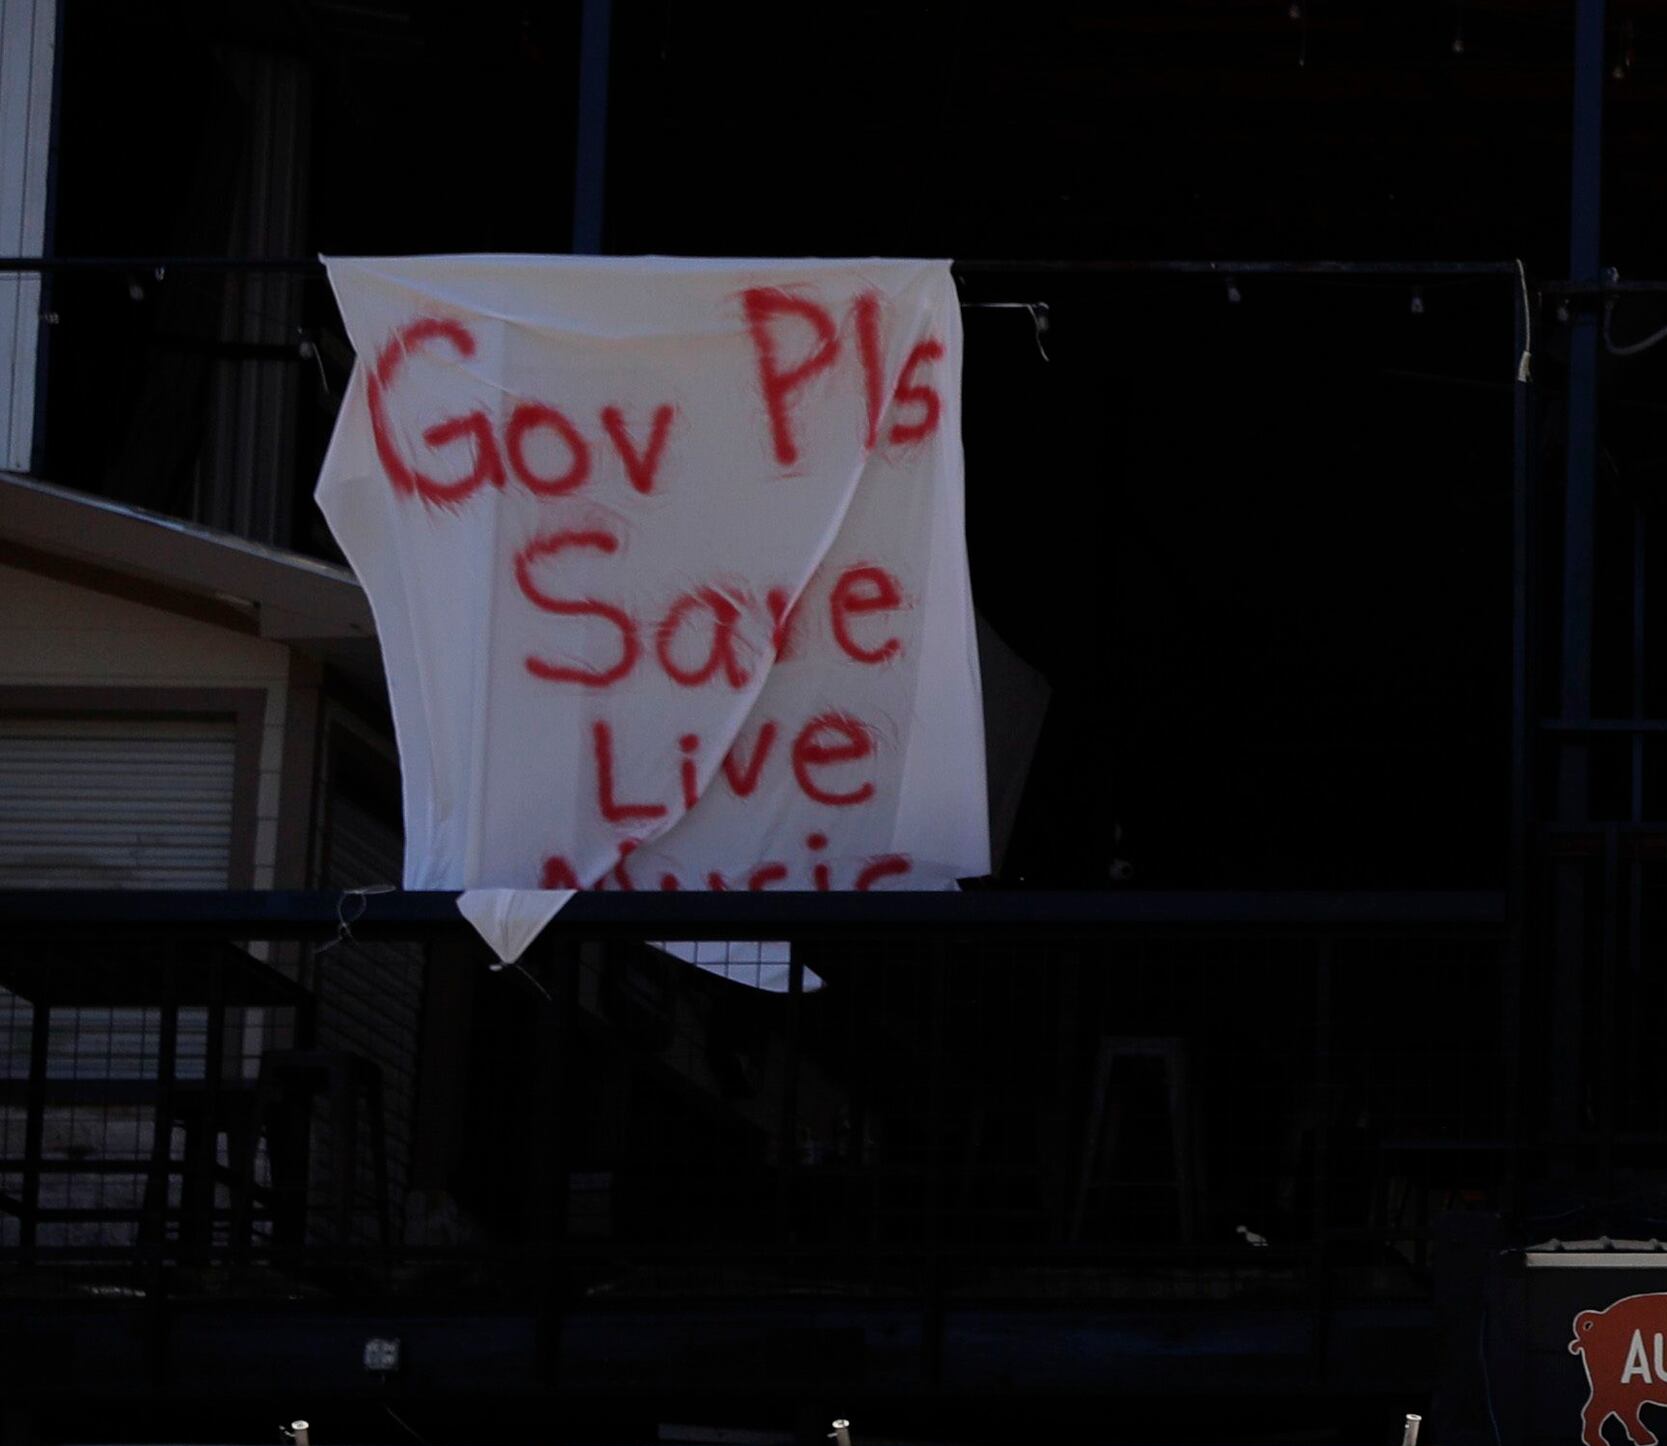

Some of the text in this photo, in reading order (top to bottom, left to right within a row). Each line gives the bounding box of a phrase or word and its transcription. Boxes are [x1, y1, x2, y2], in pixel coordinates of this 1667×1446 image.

[367, 288, 946, 502] Gov Pls
[515, 530, 905, 688] Save
[594, 712, 876, 823] Live
